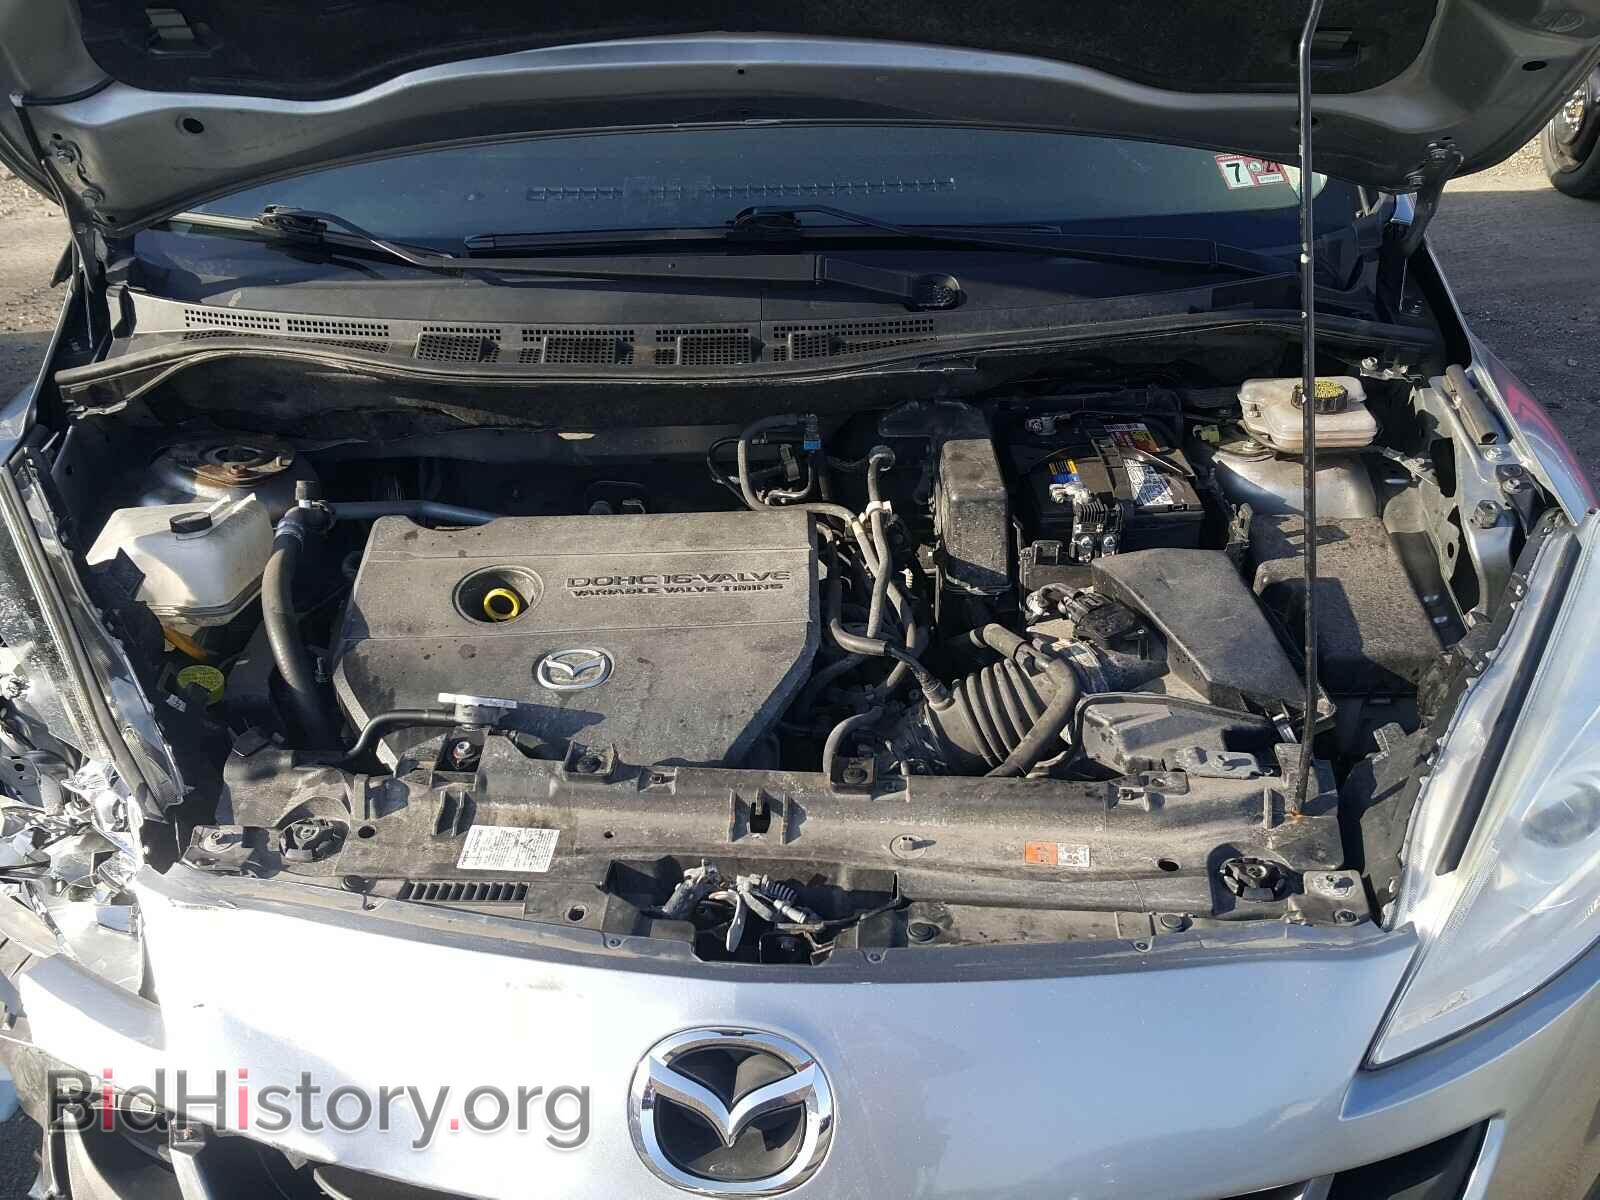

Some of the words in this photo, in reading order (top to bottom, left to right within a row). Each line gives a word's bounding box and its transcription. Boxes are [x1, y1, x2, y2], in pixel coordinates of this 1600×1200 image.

[1226, 163, 1240, 182] 7
[567, 575, 657, 587] DOHC
[662, 571, 790, 584] 16-VALVE
[572, 587, 660, 597] VARIABLE
[664, 585, 720, 594] VALVE
